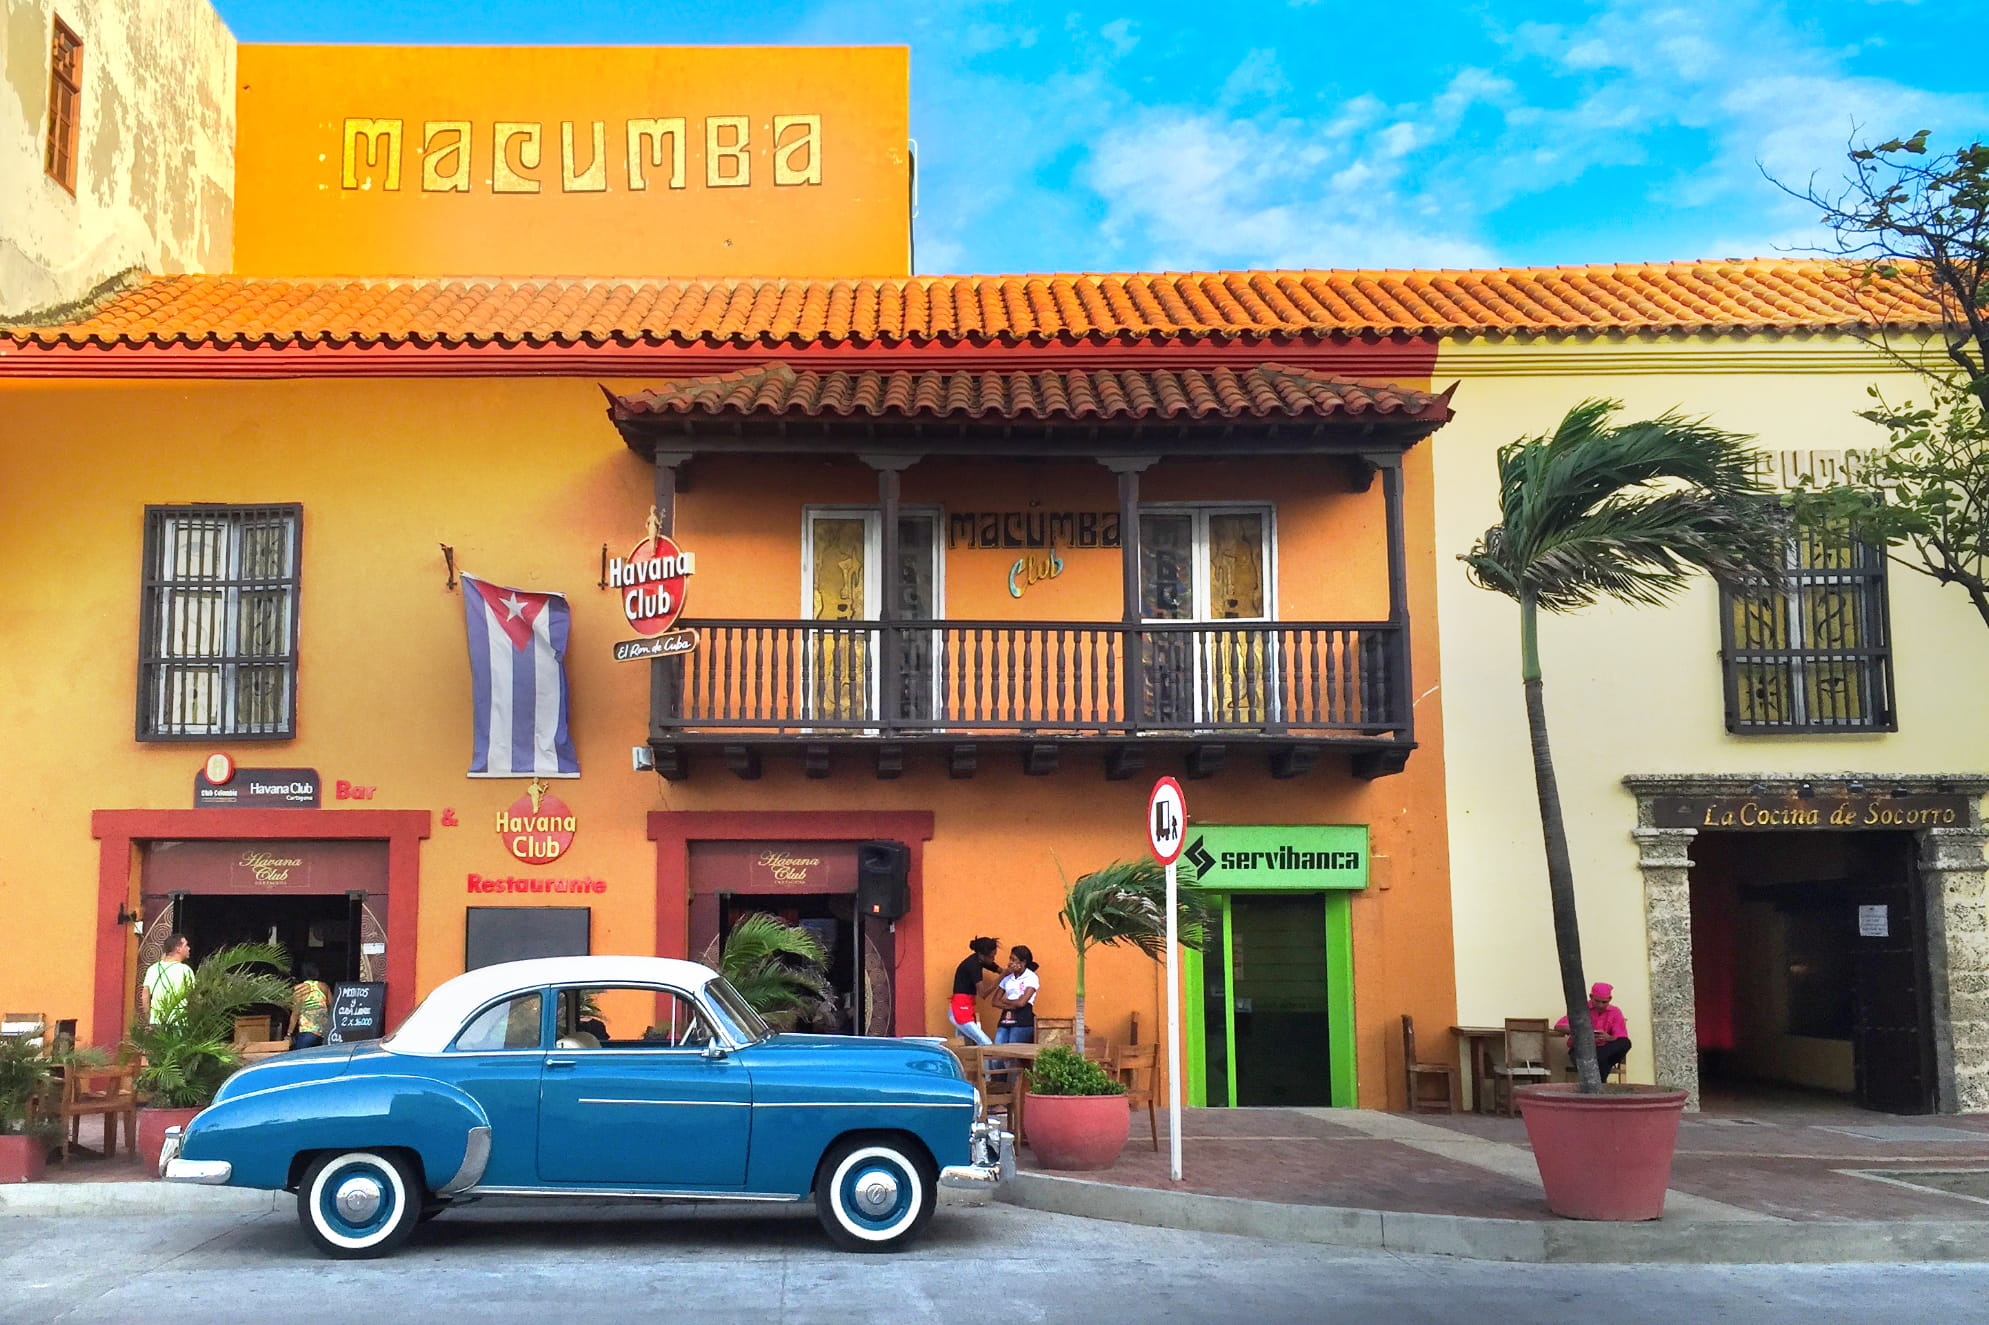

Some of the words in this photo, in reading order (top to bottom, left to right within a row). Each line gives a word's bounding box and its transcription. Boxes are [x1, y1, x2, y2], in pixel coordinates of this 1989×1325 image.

[609, 552, 690, 588] Havana
[1008, 549, 1064, 598] Club
[625, 585, 671, 620] Club
[617, 643, 628, 659] El
[630, 643, 651, 657] Ron
[651, 640, 662, 654] de
[663, 635, 692, 651] Cuba
[250, 782, 289, 795] Havana
[290, 782, 313, 795] Club
[335, 780, 377, 800] Bar
[441, 808, 459, 827] &
[496, 811, 577, 833] Havana
[1704, 804, 1734, 826] La
[1740, 802, 1819, 826] Cocina
[1830, 802, 1857, 825] de
[1864, 801, 1956, 825] Socorro
[513, 836, 560, 858] Club
[239, 850, 303, 866] Havana
[757, 850, 820, 866] Havana
[253, 866, 288, 880] Club
[467, 873, 607, 894] Restaurante
[771, 866, 806, 880] Club
